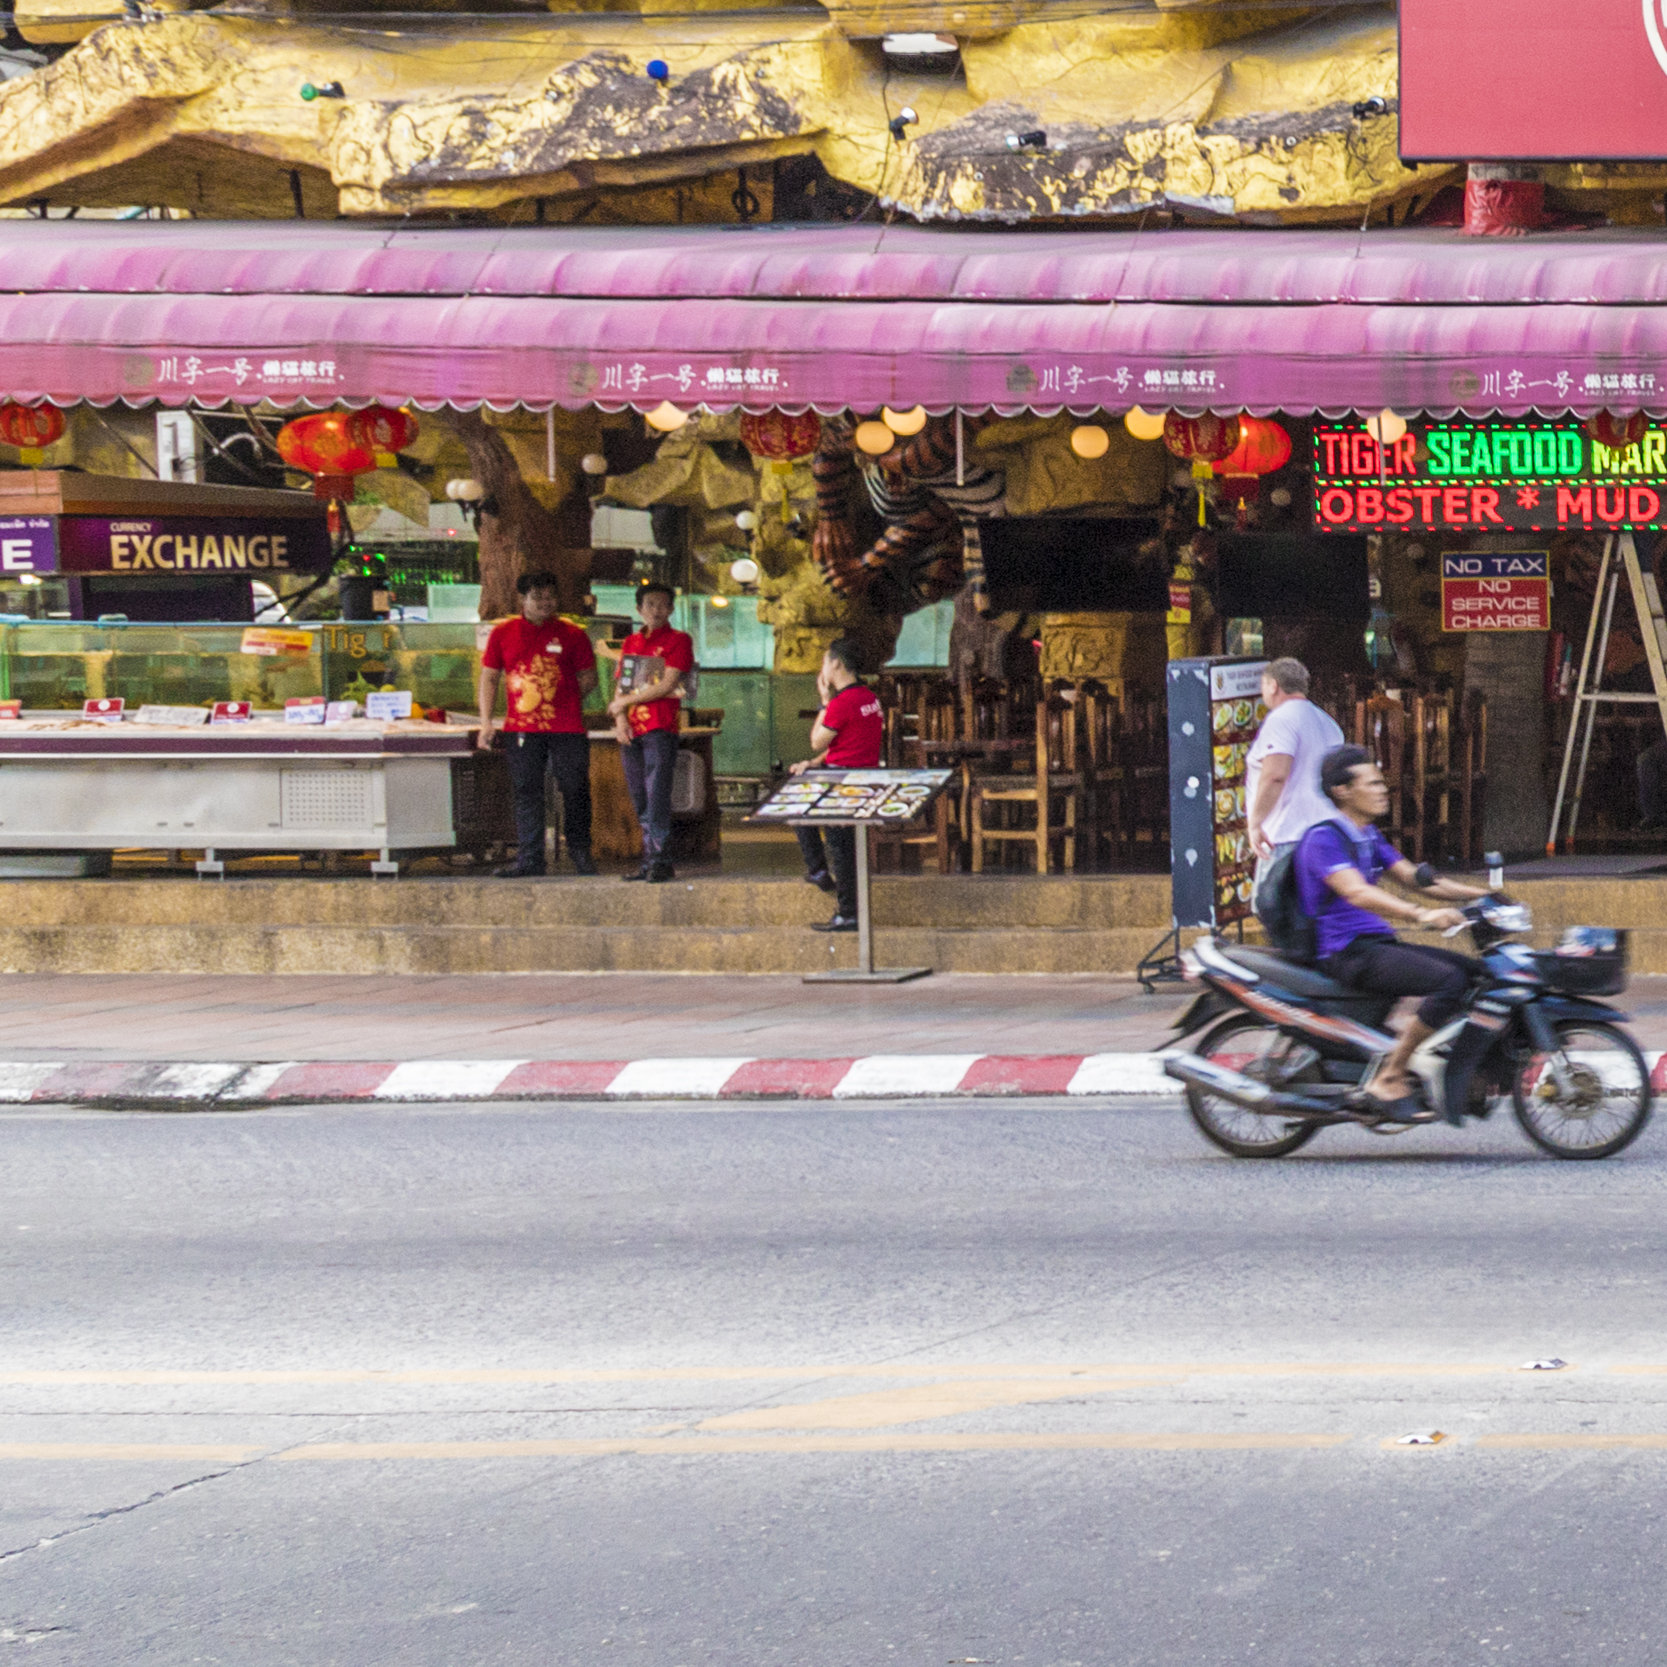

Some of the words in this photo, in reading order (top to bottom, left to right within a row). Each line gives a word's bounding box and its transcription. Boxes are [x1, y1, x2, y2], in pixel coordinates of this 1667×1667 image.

[158, 356, 253, 385] 川字一号
[602, 363, 696, 392] 川字一号
[1041, 365, 1133, 394] 川字一号
[1482, 370, 1574, 398] 川字一号
[1319, 432, 1417, 475] TIGER
[1427, 431, 1582, 475] SEAFOOD
[1321, 487, 1504, 523] OBSTER
[1557, 487, 1660, 523] MUD
[110, 522, 152, 533] CURRENCY
[110, 534, 290, 569] EXCHANGE
[1445, 559, 1482, 574] NO
[1491, 558, 1544, 574] TAX
[1479, 580, 1512, 593] NO
[1451, 597, 1540, 611] SERVICE
[1451, 614, 1541, 629] CHARGE
